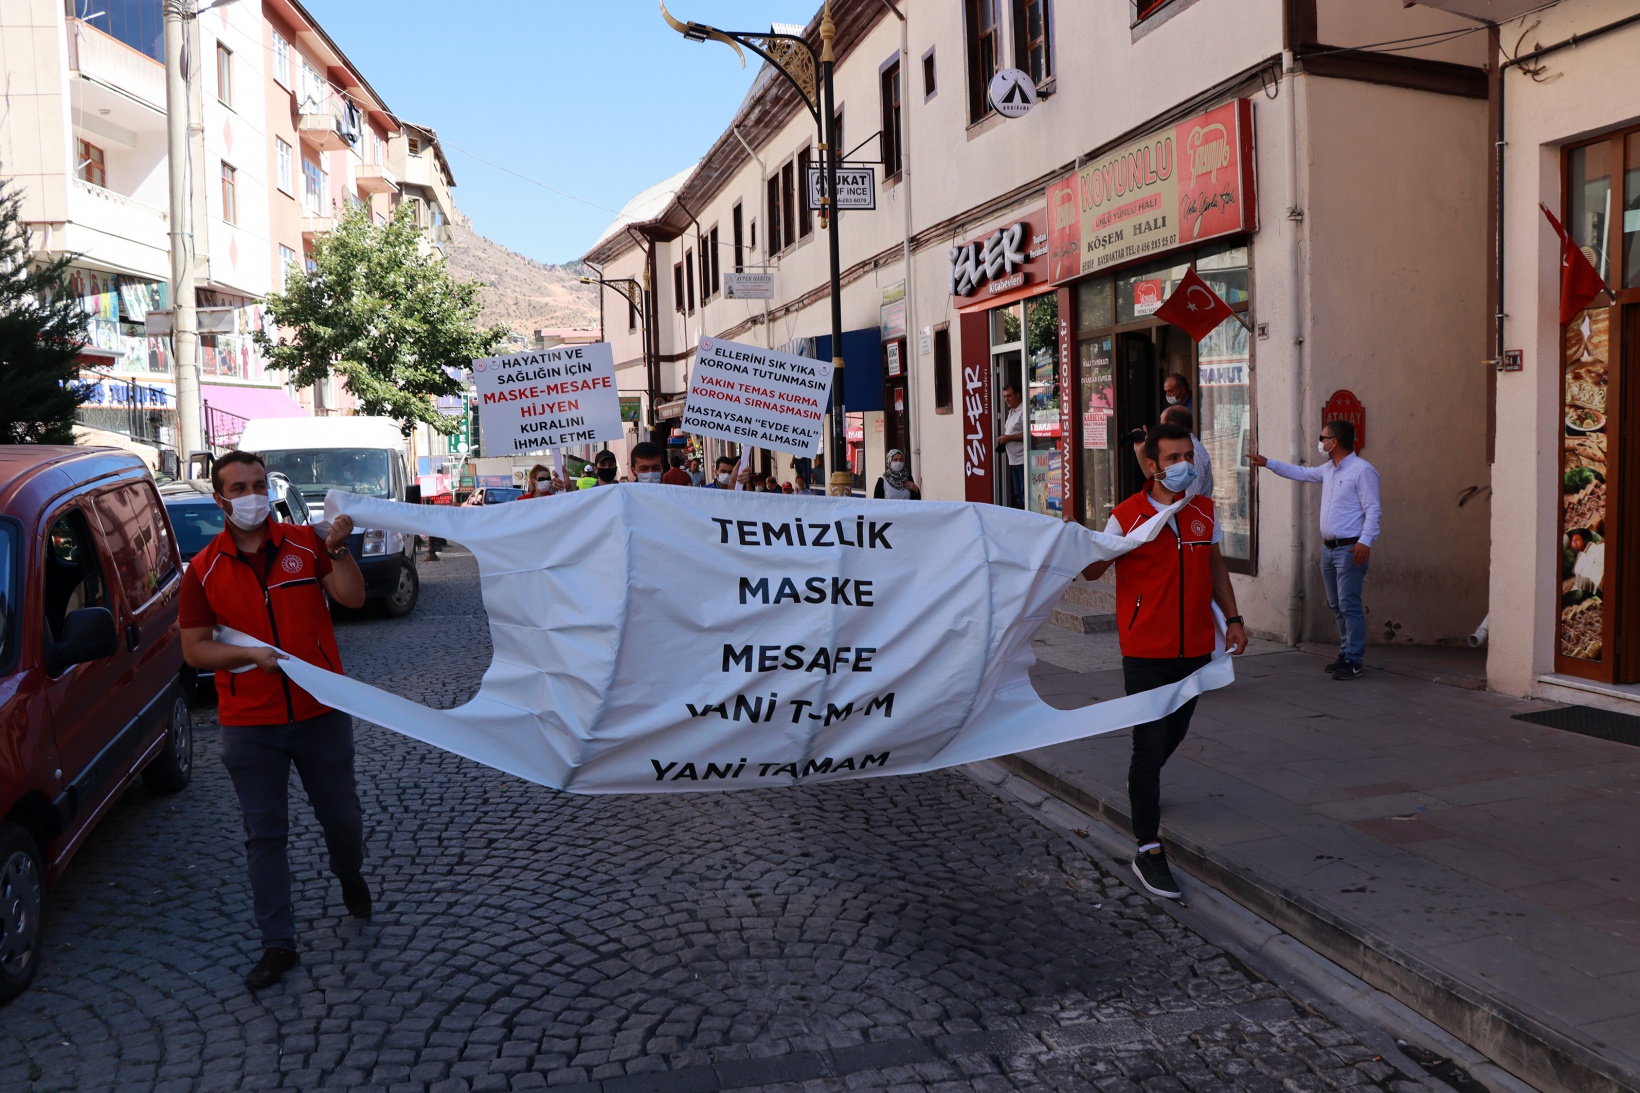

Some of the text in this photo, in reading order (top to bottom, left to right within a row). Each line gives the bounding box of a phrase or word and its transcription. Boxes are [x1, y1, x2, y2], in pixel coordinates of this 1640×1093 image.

[1081, 137, 1173, 212] KOYUNLU
[815, 187, 844, 196] YUUF
[1095, 198, 1157, 228] ÜNLÜ YÜNLÜ HALI
[1087, 229, 1124, 253] KÖŞEM
[1133, 215, 1167, 237] HALI
[1097, 247, 1125, 267] BAYRAKTAR
[1151, 239, 1160, 250] 213
[1162, 236, 1169, 247] 25
[1170, 234, 1177, 244] 07
[989, 273, 1022, 294] Kitabevleri
[497, 362, 592, 385] SAĞLIĞIN İÇİN
[502, 348, 583, 369] HAYATIN VE
[700, 357, 826, 391] KORONA TUTUNMASIN
[714, 347, 816, 377] ELLERİNİ SIK YIKA
[483, 376, 612, 405] MASKE-MESAFE
[692, 386, 822, 421] KORONA SIRNAŞMASIN
[700, 375, 818, 408] YAKIN TEMAS KURMA
[520, 399, 579, 418] HİJYEN
[687, 404, 753, 425] HASTAYSAN
[755, 418, 789, 433] “EVDE
[791, 426, 819, 438] KAL”
[1060, 318, 1070, 499] www.isler.com.tr
[514, 430, 596, 450] İHMAL ETME
[520, 416, 585, 434] KURALINI
[684, 416, 809, 449] KORONA ESİR ALMASIN
[711, 515, 893, 549] TEMİZLİK
[739, 576, 874, 607] MASKE
[722, 644, 877, 675] MESAFE
[789, 692, 895, 727] TMM
[650, 751, 891, 781] YANİ TAMAM
